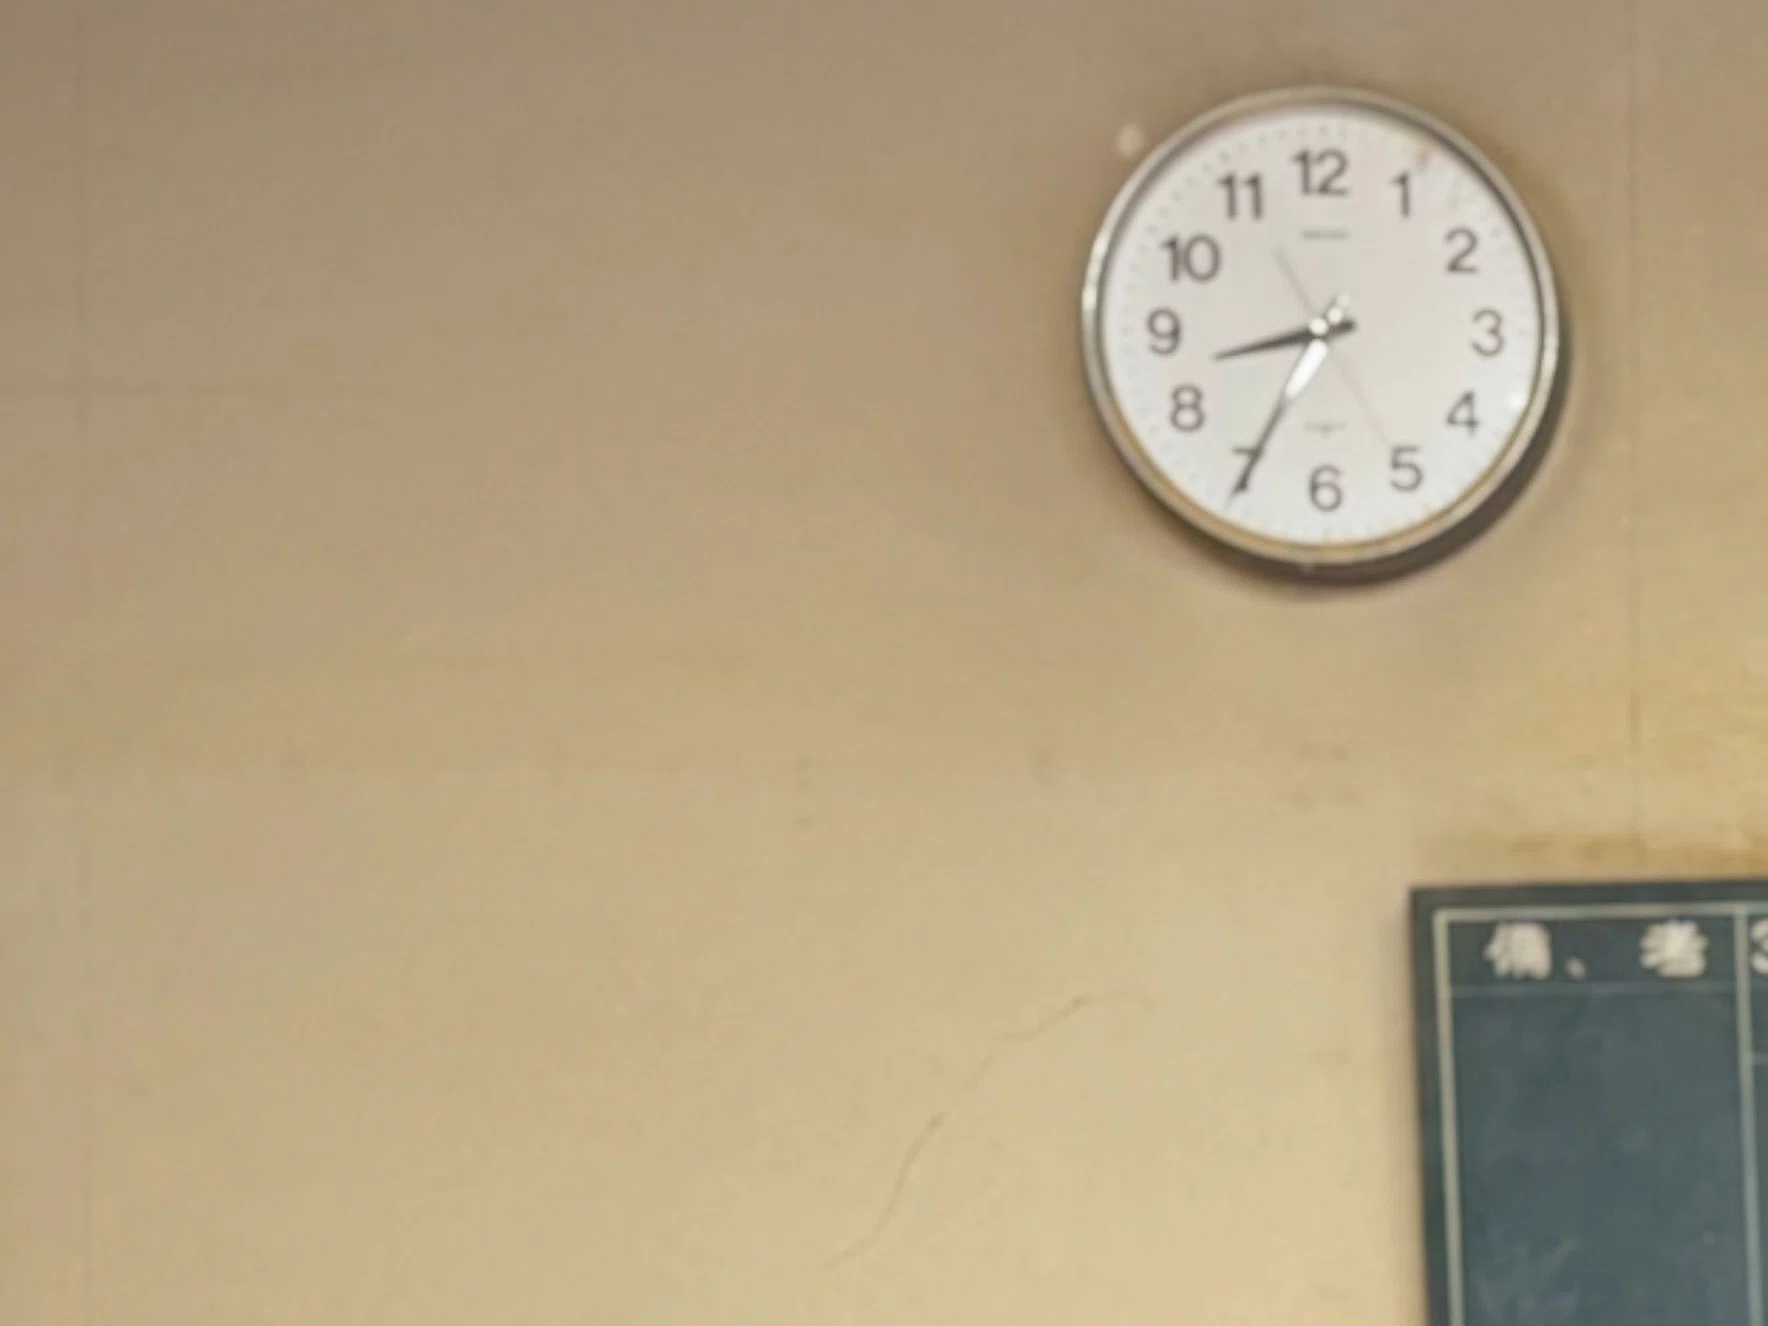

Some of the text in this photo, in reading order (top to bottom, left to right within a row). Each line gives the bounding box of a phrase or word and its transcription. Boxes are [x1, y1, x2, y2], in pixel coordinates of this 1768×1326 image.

[1217, 172, 1265, 221] 11
[1292, 148, 1349, 197] 12
[1392, 172, 1412, 218] 1
[1160, 234, 1222, 283] 10
[1444, 227, 1480, 275] 2
[1146, 307, 1183, 356] 9
[1470, 307, 1505, 358] 3
[1169, 383, 1206, 433] 8
[1445, 390, 1481, 435] 4
[1232, 445, 1263, 493] 7
[1308, 463, 1344, 513] 6
[1389, 444, 1425, 493] 5
